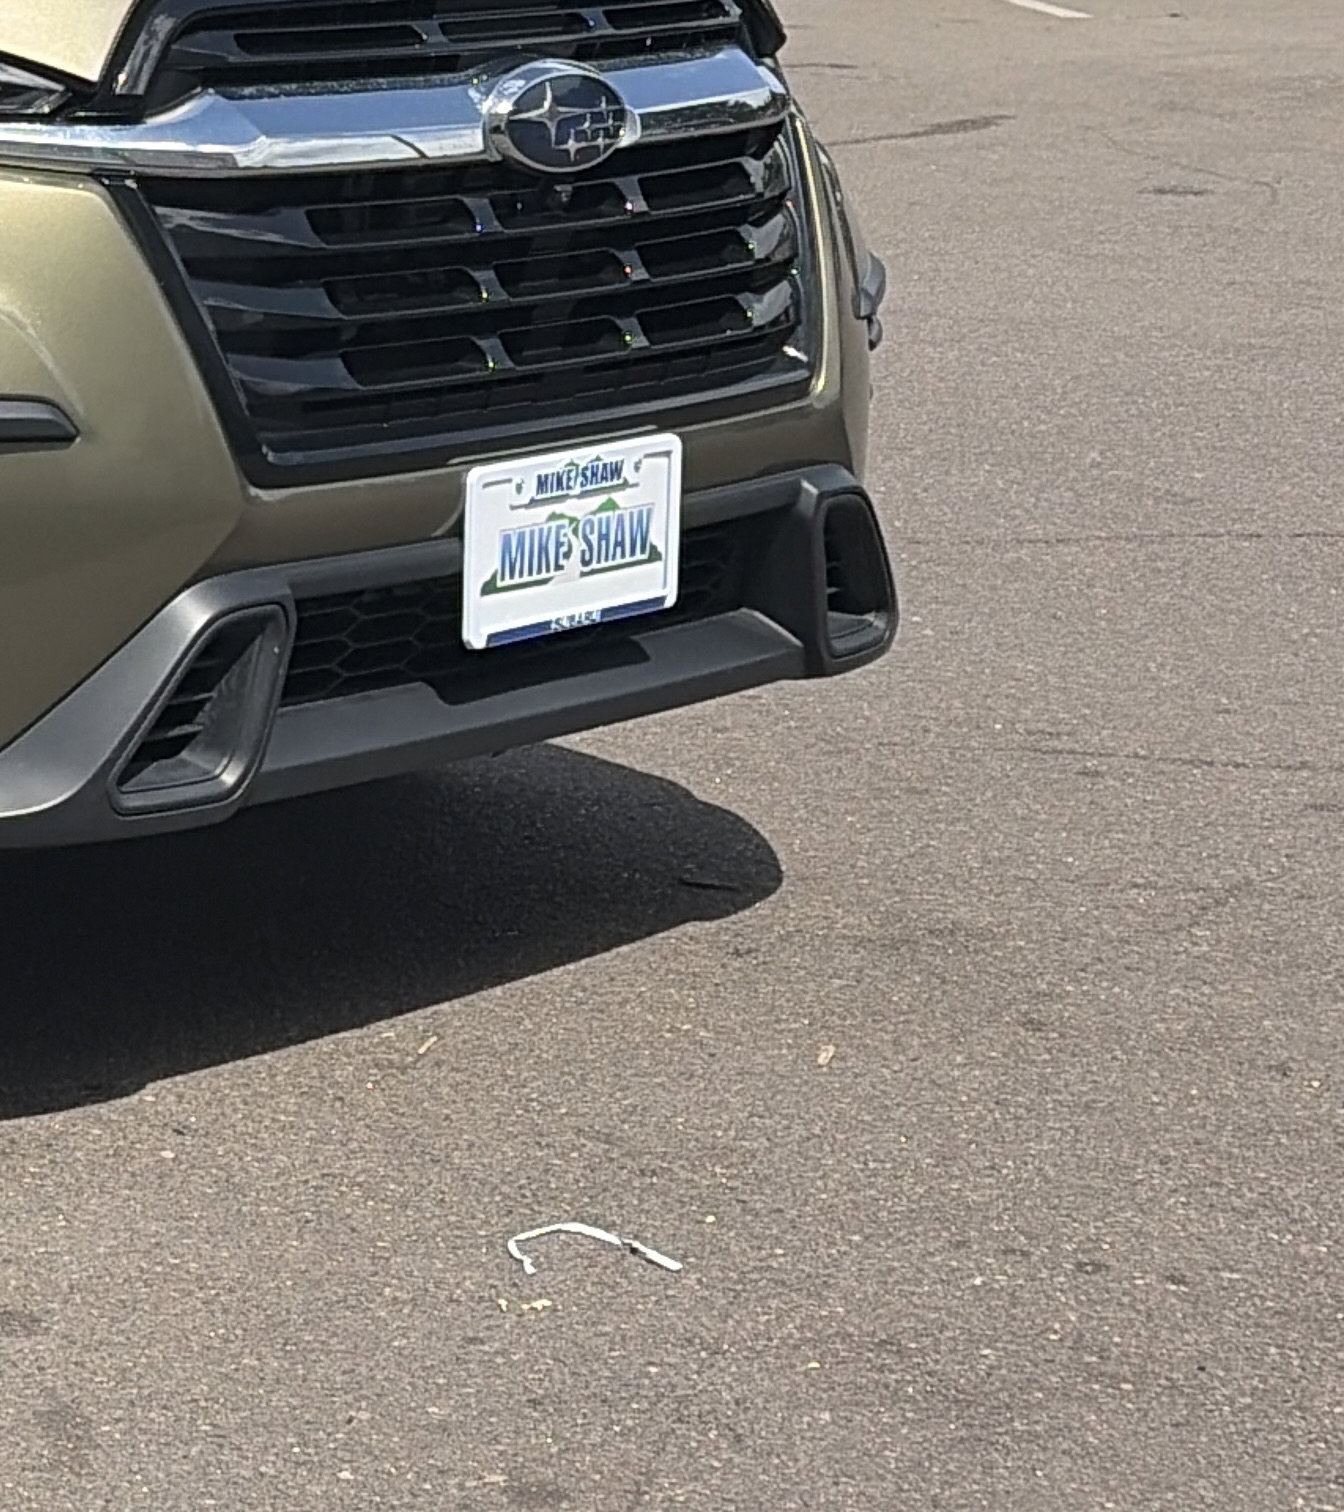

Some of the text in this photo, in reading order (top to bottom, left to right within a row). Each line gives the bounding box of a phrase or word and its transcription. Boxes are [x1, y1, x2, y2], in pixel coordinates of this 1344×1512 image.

[536, 459, 624, 495] MIKE SHAW
[500, 508, 653, 581] MIKE SHAW
